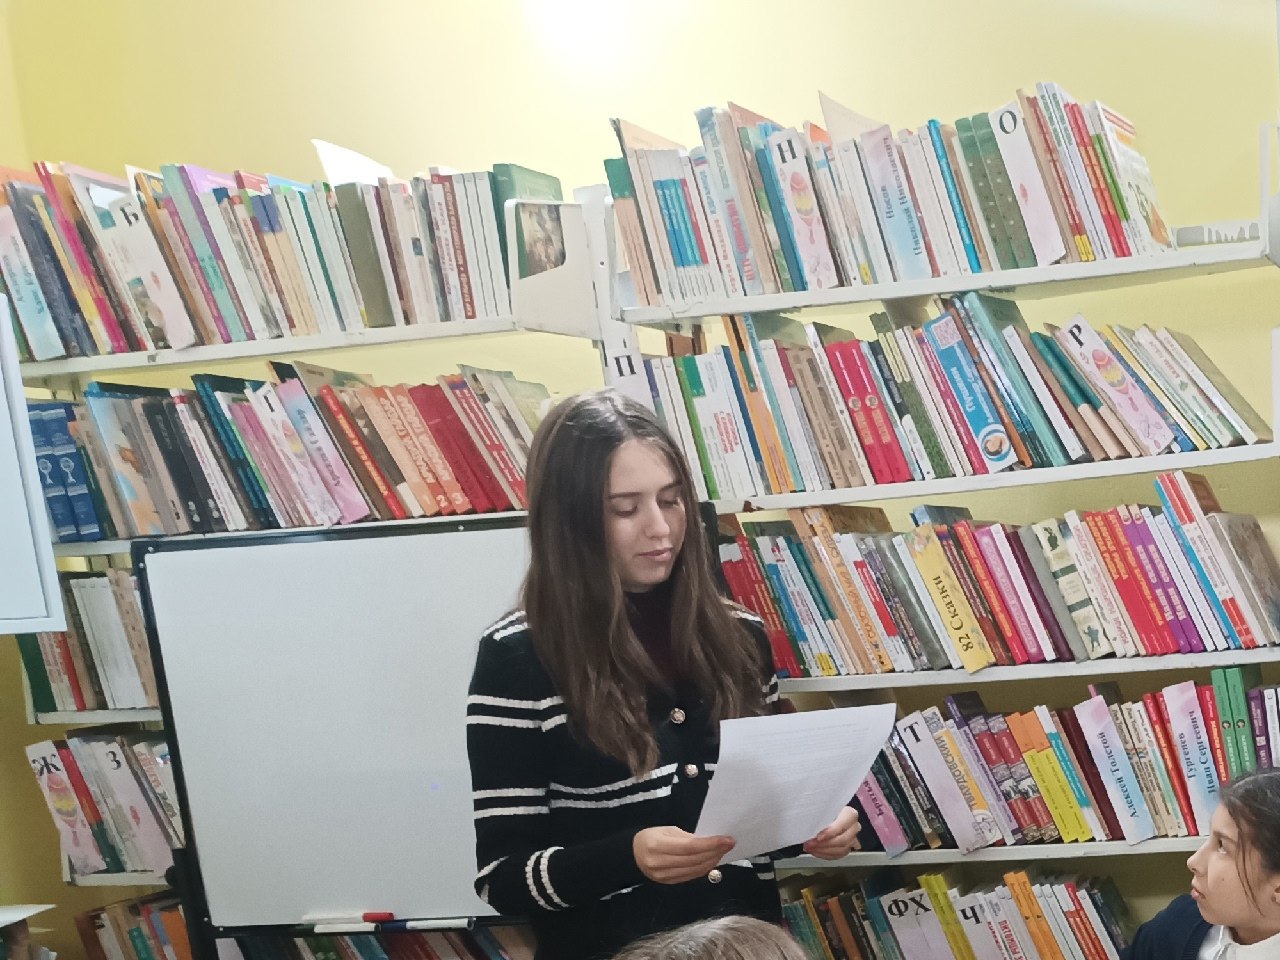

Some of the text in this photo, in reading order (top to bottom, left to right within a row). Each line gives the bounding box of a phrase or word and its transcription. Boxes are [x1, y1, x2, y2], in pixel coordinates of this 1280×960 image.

[777, 138, 797, 164] Н
[1067, 323, 1084, 348] Р
[436, 495, 449, 508] 2
[452, 492, 463, 504] 3
[932, 575, 974, 652] 82 Сказки
[904, 720, 921, 744] Т
[1179, 732, 1198, 780] Тургенев
[1188, 710, 1217, 794] Иван Сергеевич
[32, 754, 61, 776] Ж
[936, 735, 978, 812] ТВАРДОВСКИЙ
[1099, 731, 1140, 819] Алексей Толстой
[887, 898, 910, 918] Ф
[960, 907, 982, 925] Ч
